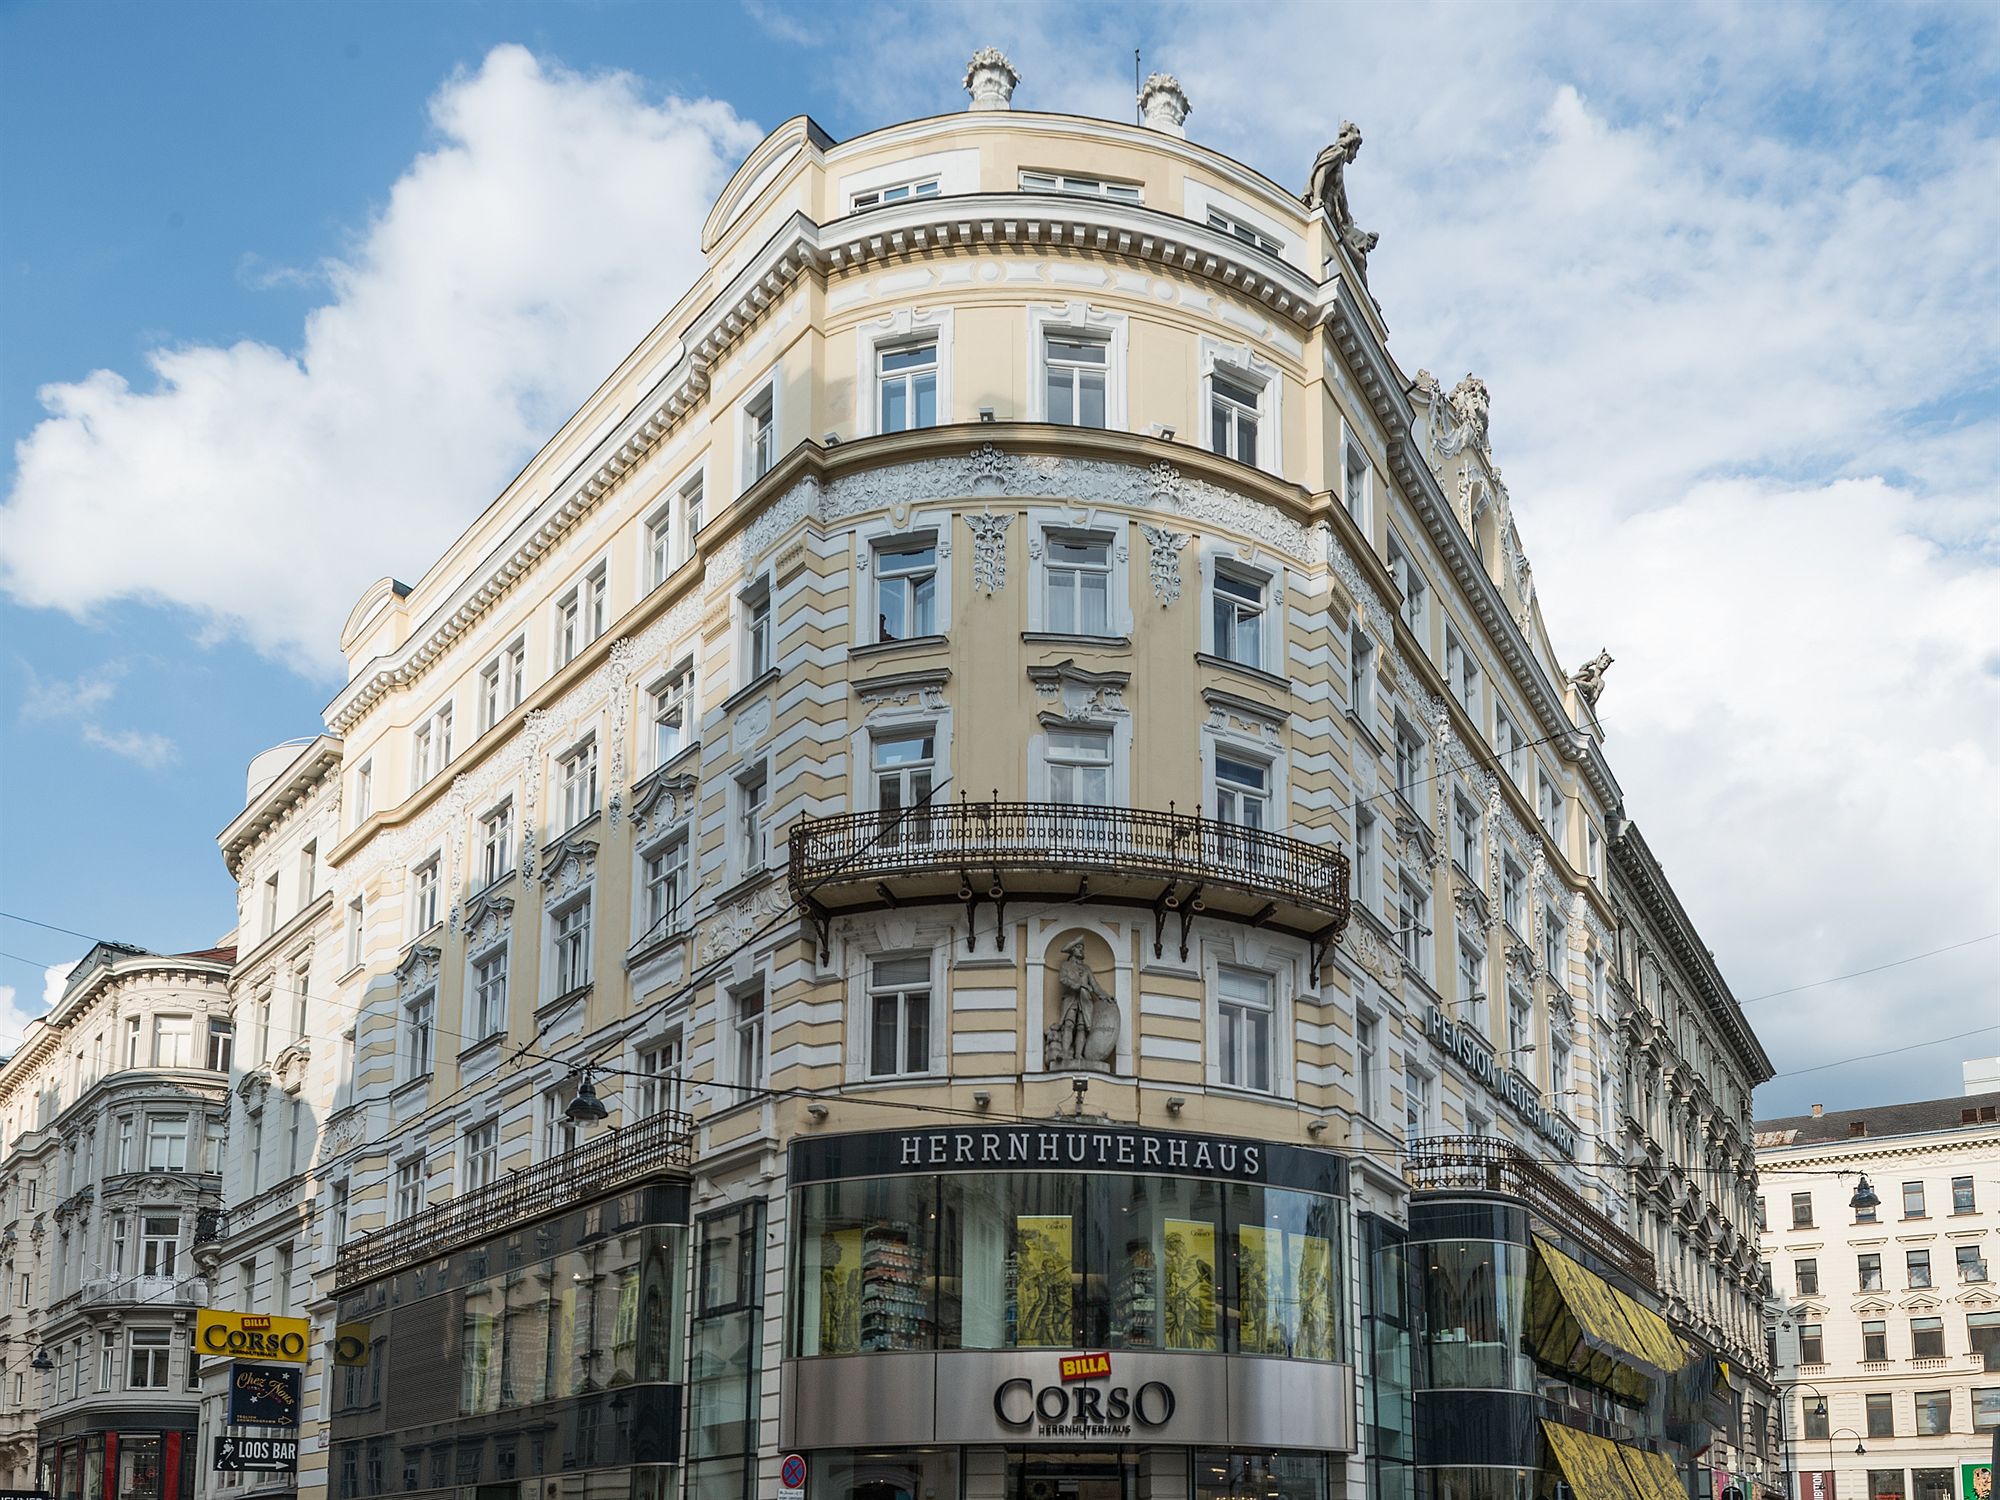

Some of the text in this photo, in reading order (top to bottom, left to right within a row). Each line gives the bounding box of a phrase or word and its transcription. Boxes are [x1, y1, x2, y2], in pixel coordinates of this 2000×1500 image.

[1428, 1006, 1496, 1089] PENSION
[1497, 1069, 1541, 1127] NEUER
[900, 1133, 1260, 1174] HERRNHUTERHAUS
[243, 1319, 270, 1327] BILLA
[204, 1324, 304, 1356] CORSO
[1063, 1357, 1109, 1376] BILLA
[236, 1372, 295, 1405] Chez Nous
[993, 1377, 1176, 1427] CORSO
[1038, 1424, 1131, 1437] HERRNHUTERHAUS
[238, 1441, 296, 1460] LOOS BAR
